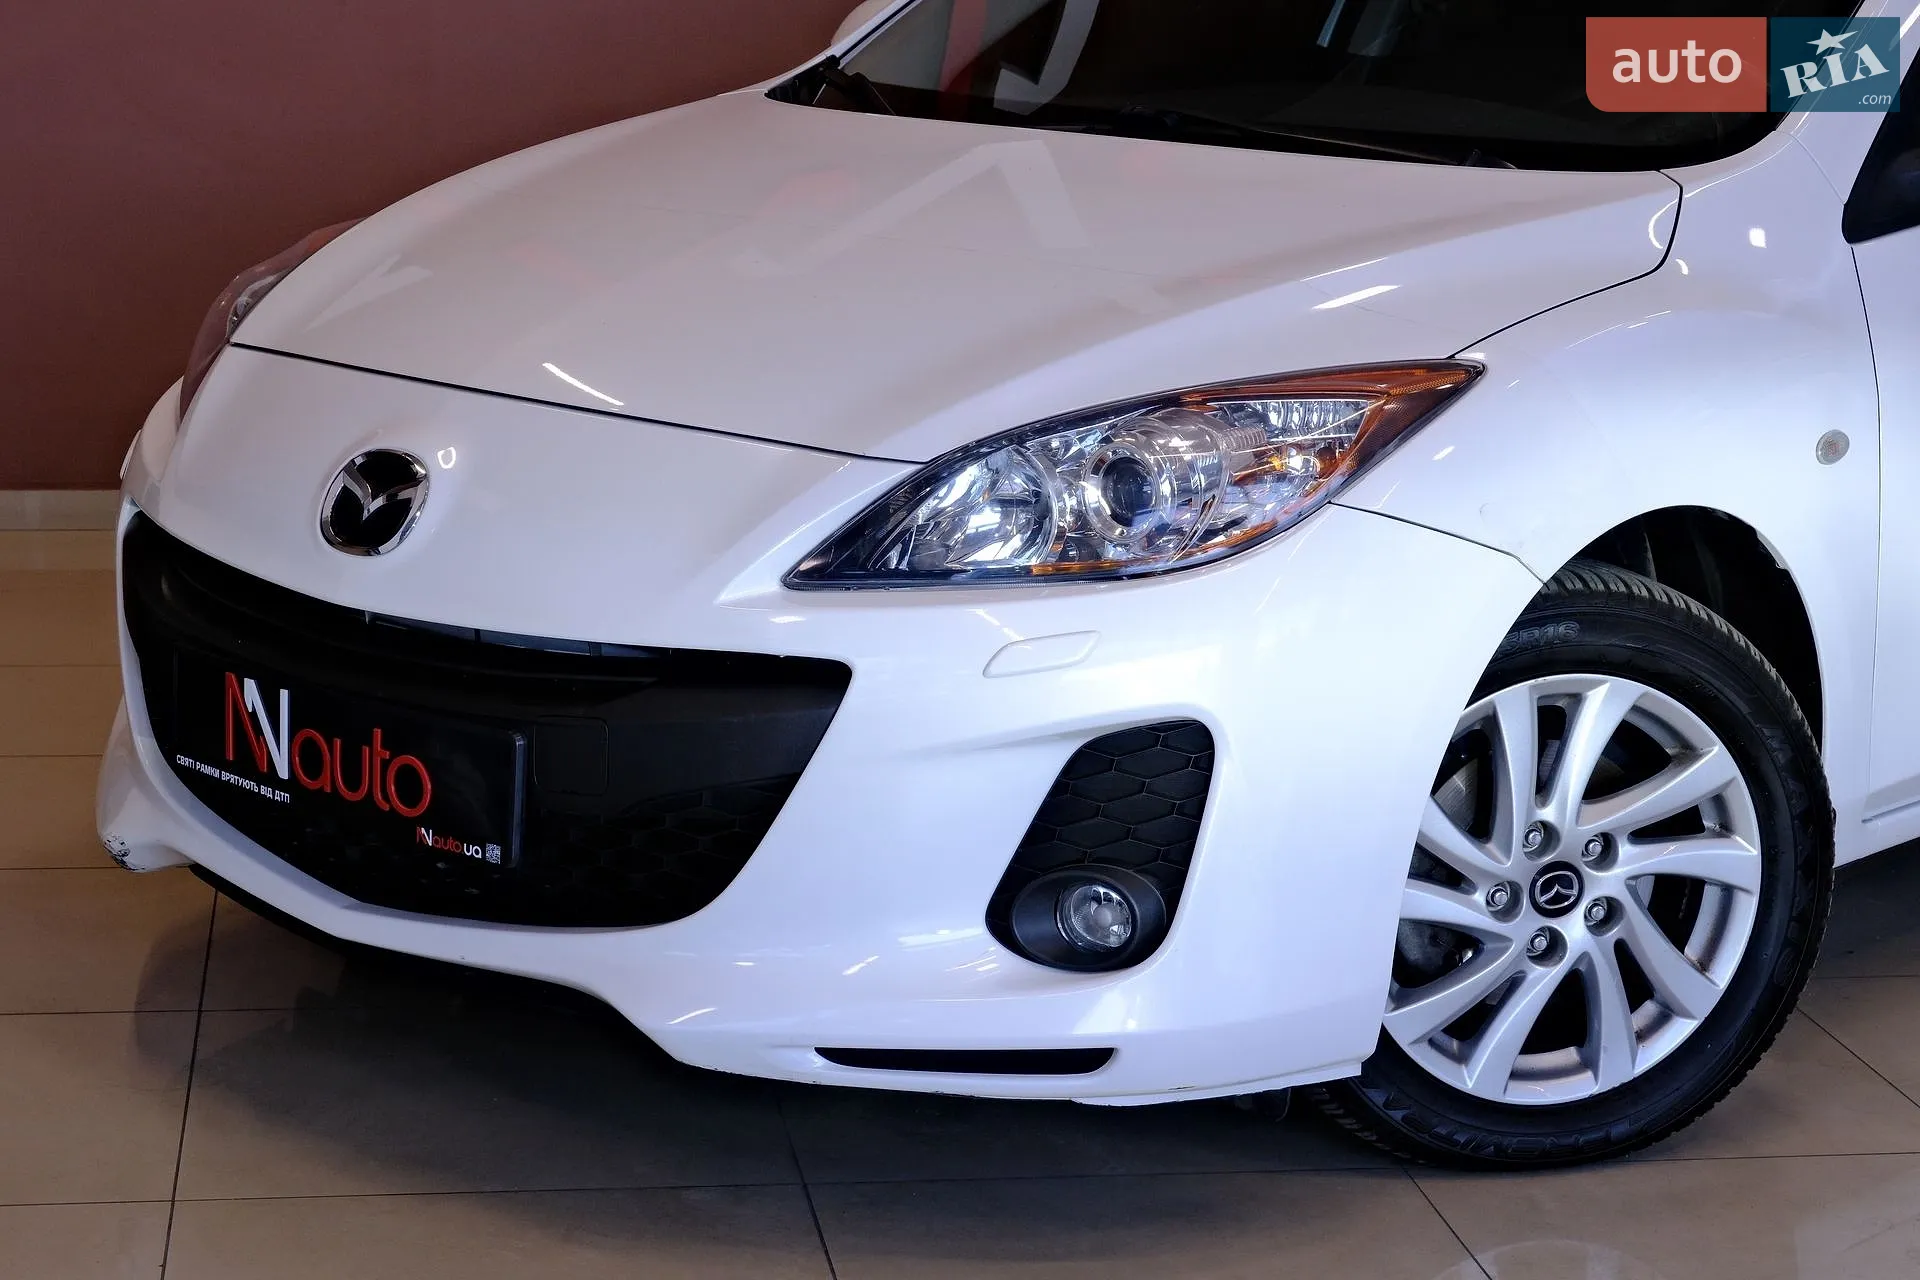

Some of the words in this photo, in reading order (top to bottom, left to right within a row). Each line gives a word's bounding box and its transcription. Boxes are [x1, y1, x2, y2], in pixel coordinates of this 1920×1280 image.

[176, 753, 195, 769] СВЯТІ
[196, 761, 220, 779] РАМКИ
[221, 770, 259, 793] ВРЯТУЮТЬ
[260, 784, 273, 799] ВІД
[274, 789, 290, 804] ДТП
